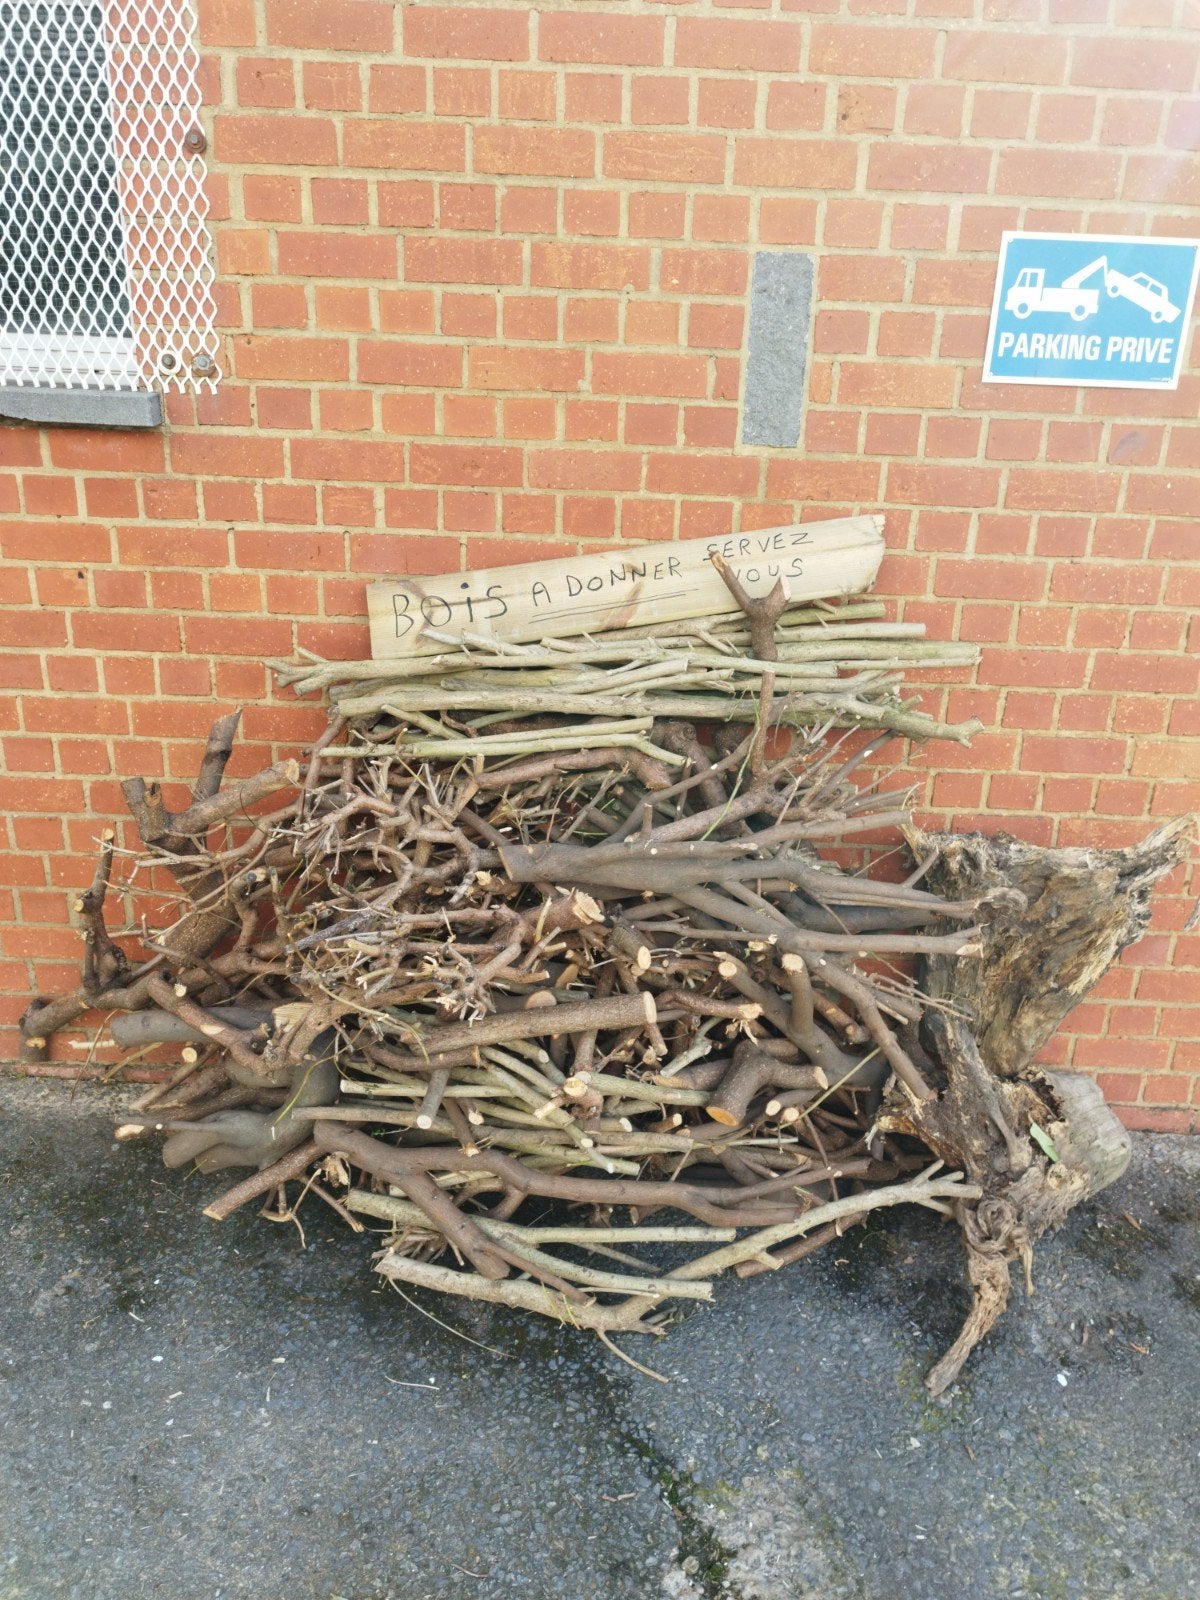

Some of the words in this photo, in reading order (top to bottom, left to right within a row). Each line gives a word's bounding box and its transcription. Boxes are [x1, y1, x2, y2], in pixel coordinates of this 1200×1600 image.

[997, 332, 1102, 361] PARKING
[1105, 336, 1175, 364] PRIVE
[702, 532, 815, 561] SERVEZ
[531, 580, 552, 607] A
[565, 556, 683, 597] DONNER
